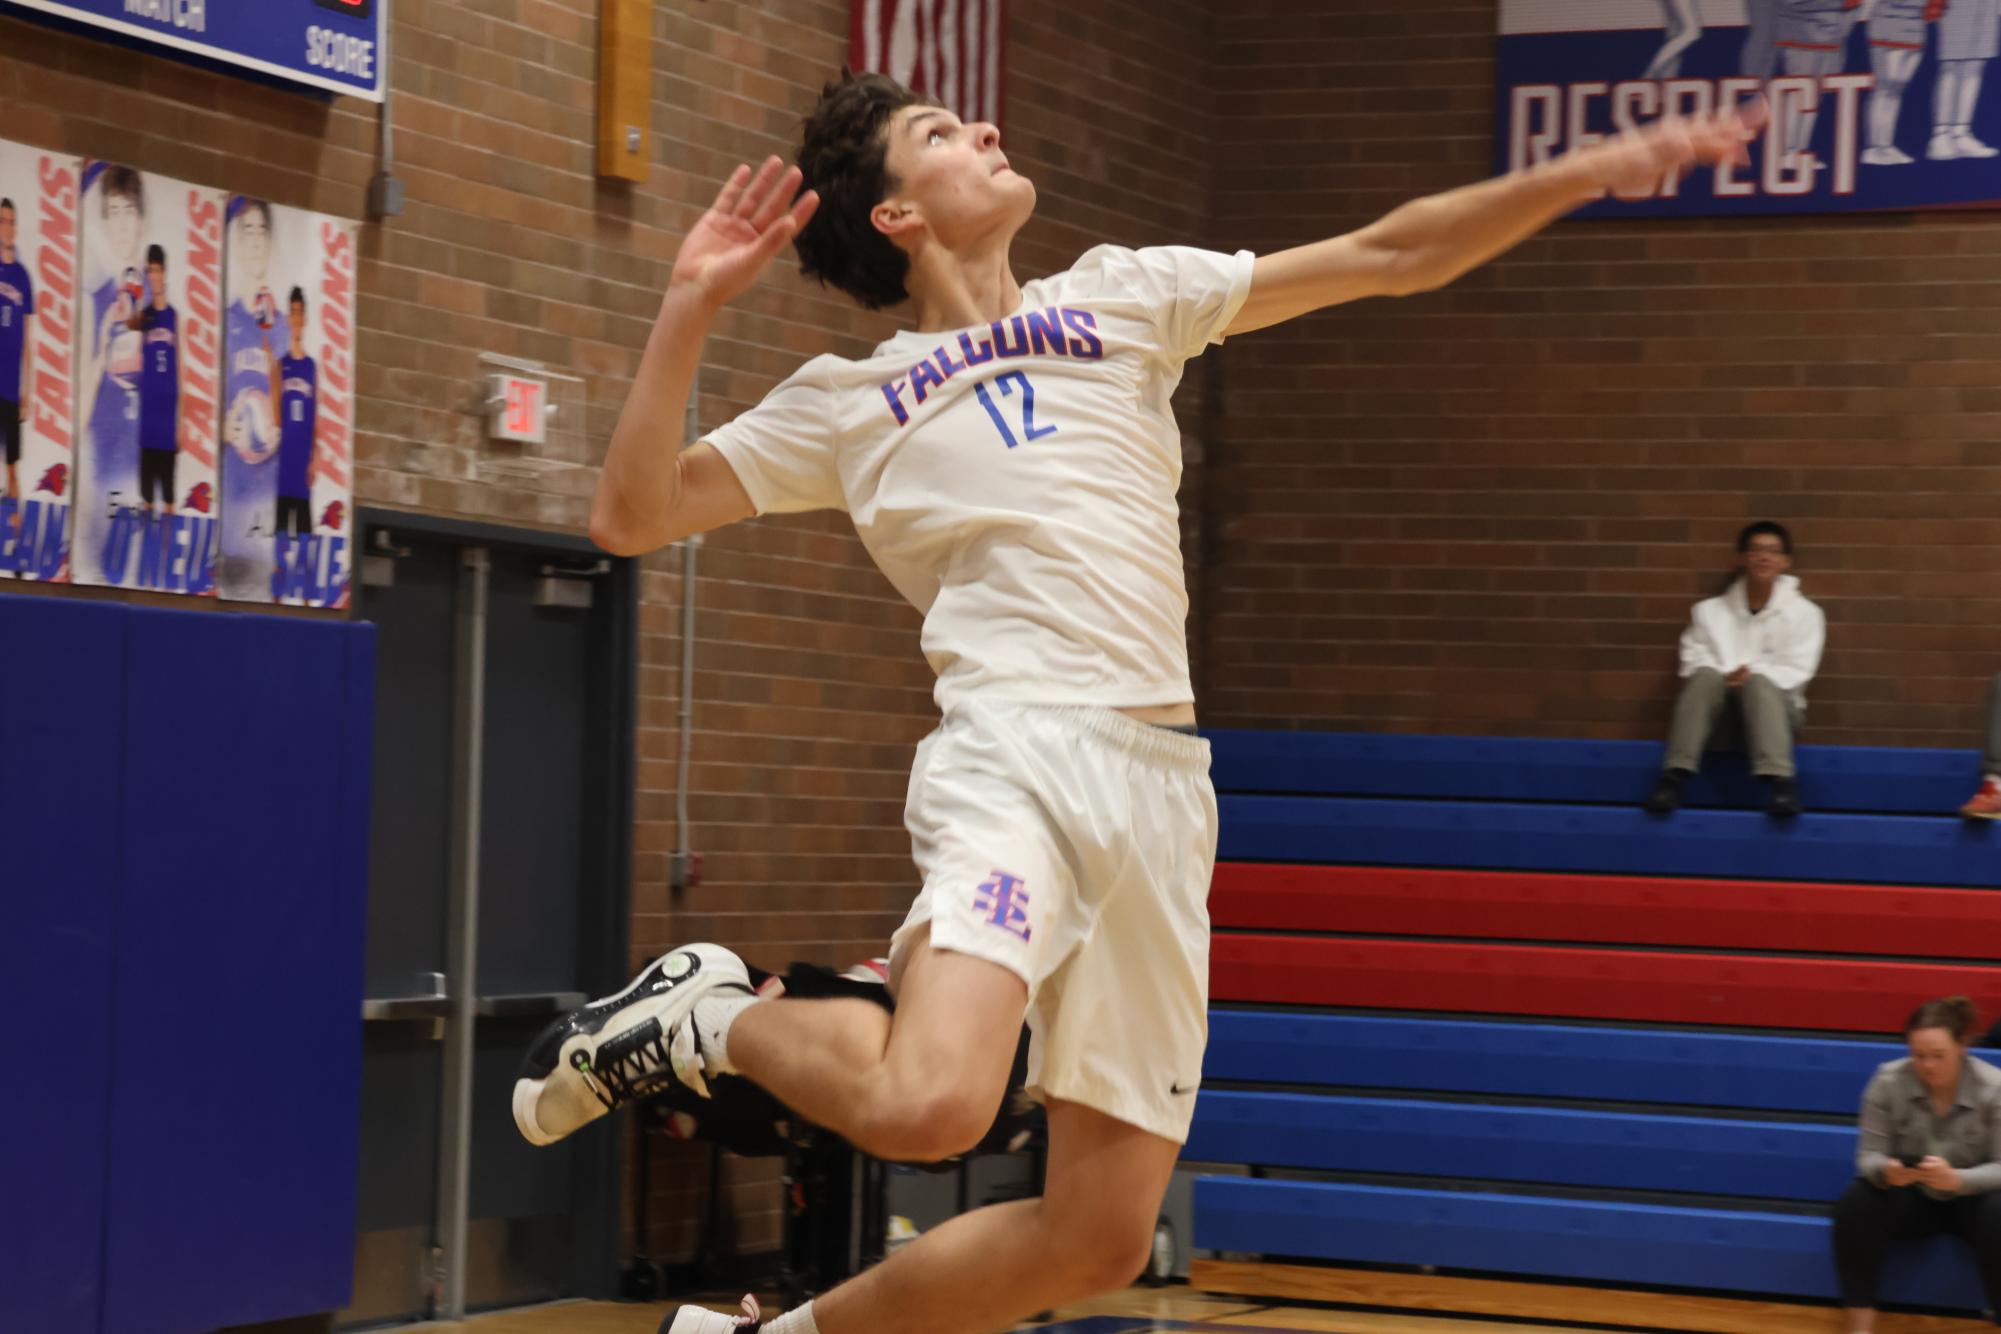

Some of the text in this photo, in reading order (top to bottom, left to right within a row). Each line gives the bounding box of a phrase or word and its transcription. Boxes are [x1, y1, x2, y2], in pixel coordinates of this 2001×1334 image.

[124, 0, 205, 32] TCH
[305, 25, 375, 79] SCORE
[34, 155, 78, 450] FALCONS
[182, 189, 223, 470] FALCONS
[314, 222, 354, 488] FALCONS
[880, 306, 1103, 427] FALCONS
[973, 369, 1059, 449] 12
